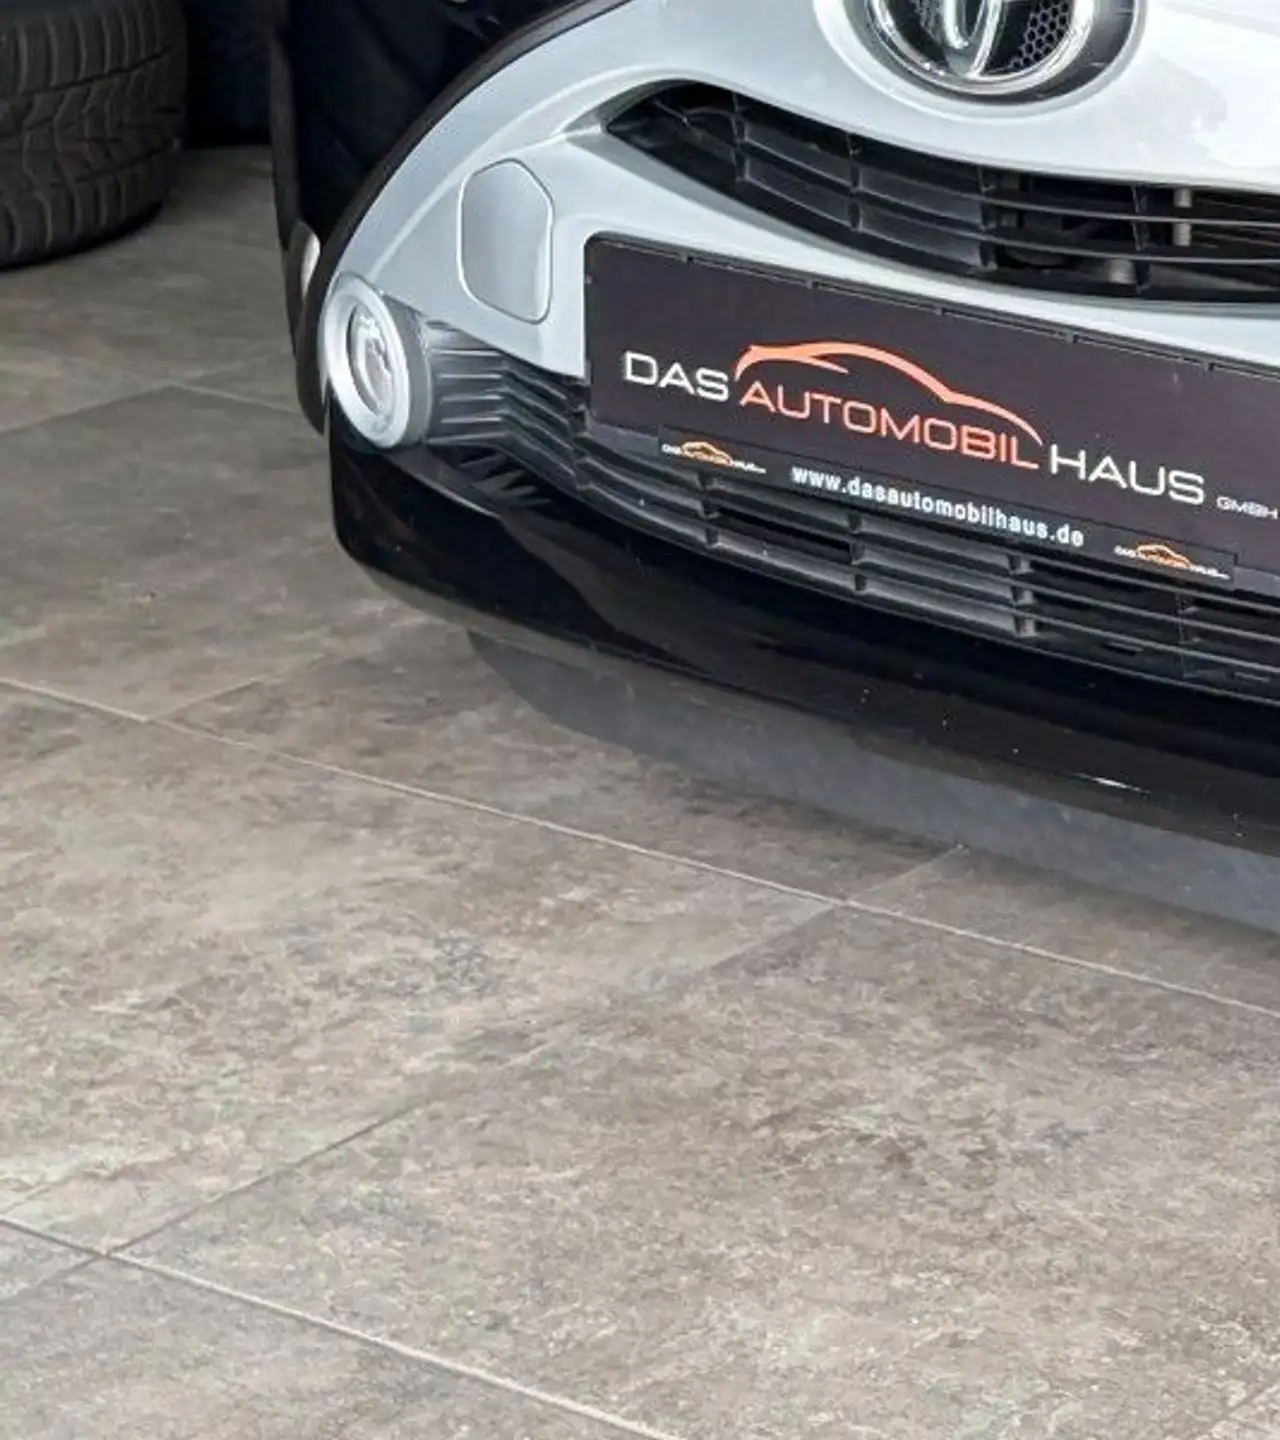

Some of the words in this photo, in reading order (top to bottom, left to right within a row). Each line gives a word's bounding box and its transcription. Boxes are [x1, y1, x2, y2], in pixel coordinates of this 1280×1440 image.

[624, 350, 730, 402] DAS
[739, 380, 1040, 470] AUTOMOBIL
[1050, 444, 1206, 505] HAUS
[791, 465, 1085, 548] www.dasautomobilhaus.de
